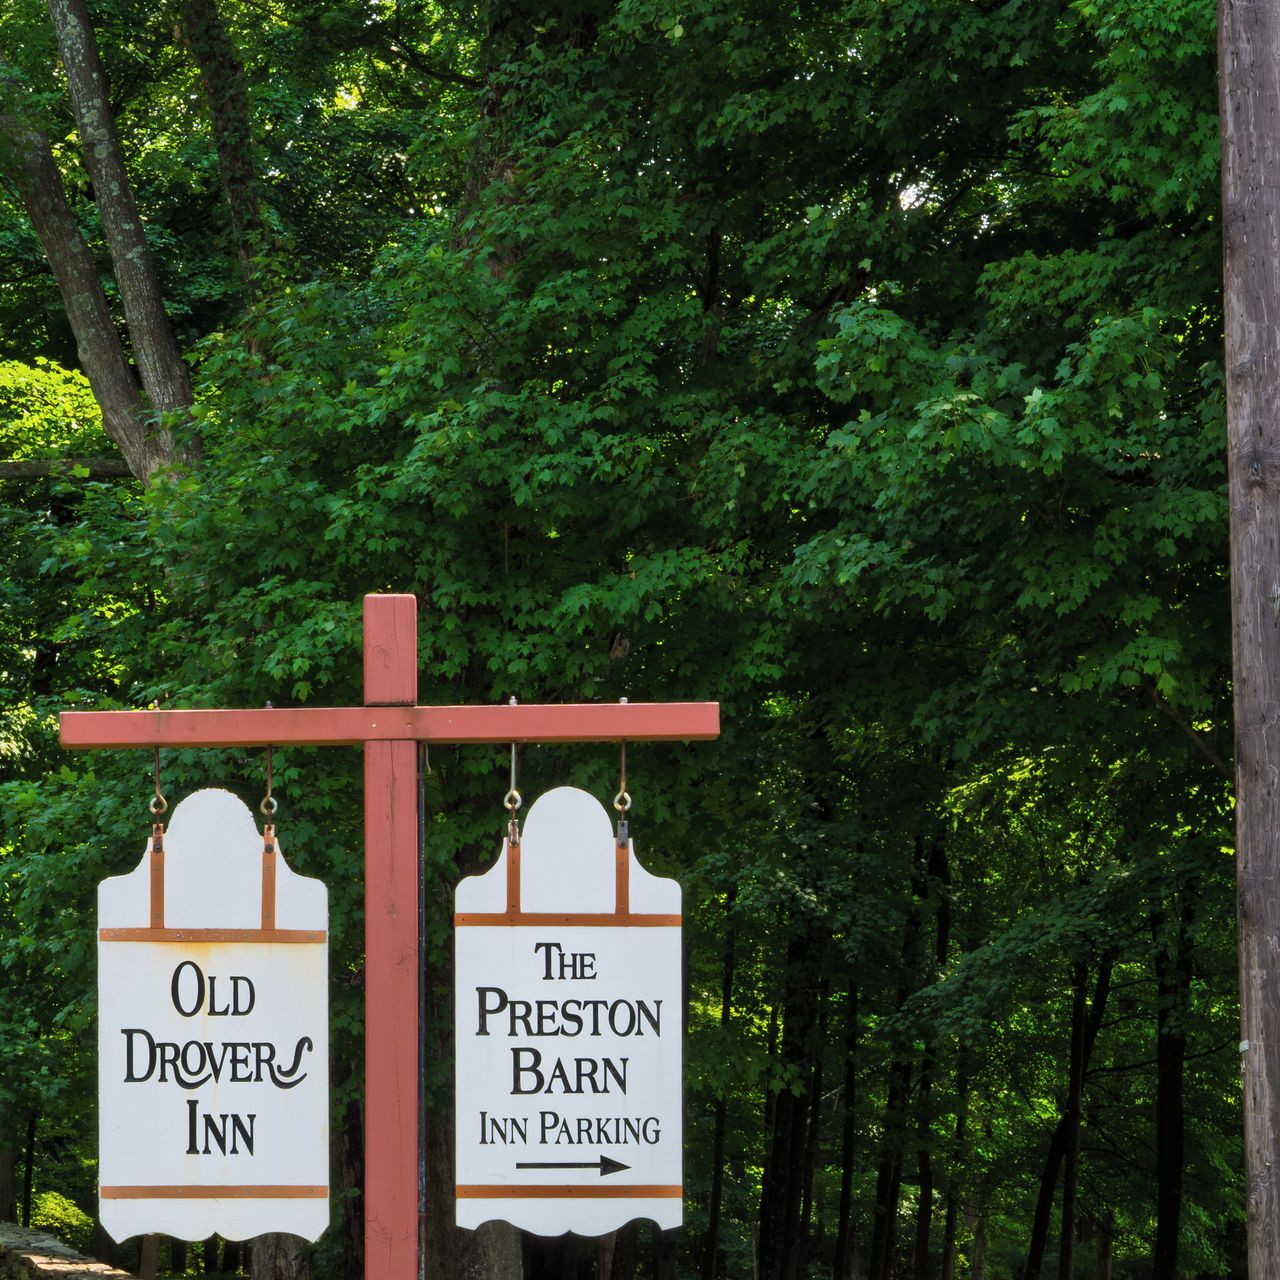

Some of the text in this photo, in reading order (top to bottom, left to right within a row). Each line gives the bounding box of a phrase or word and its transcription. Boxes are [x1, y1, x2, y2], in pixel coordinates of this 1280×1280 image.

[534, 942, 598, 981] THE
[171, 960, 256, 1018] OLD
[475, 986, 663, 1038] PRESTON
[120, 1028, 313, 1089] DROVERS
[510, 1047, 629, 1096] BARN
[186, 1099, 257, 1157] INN
[479, 1111, 661, 1146] INN PARKING
